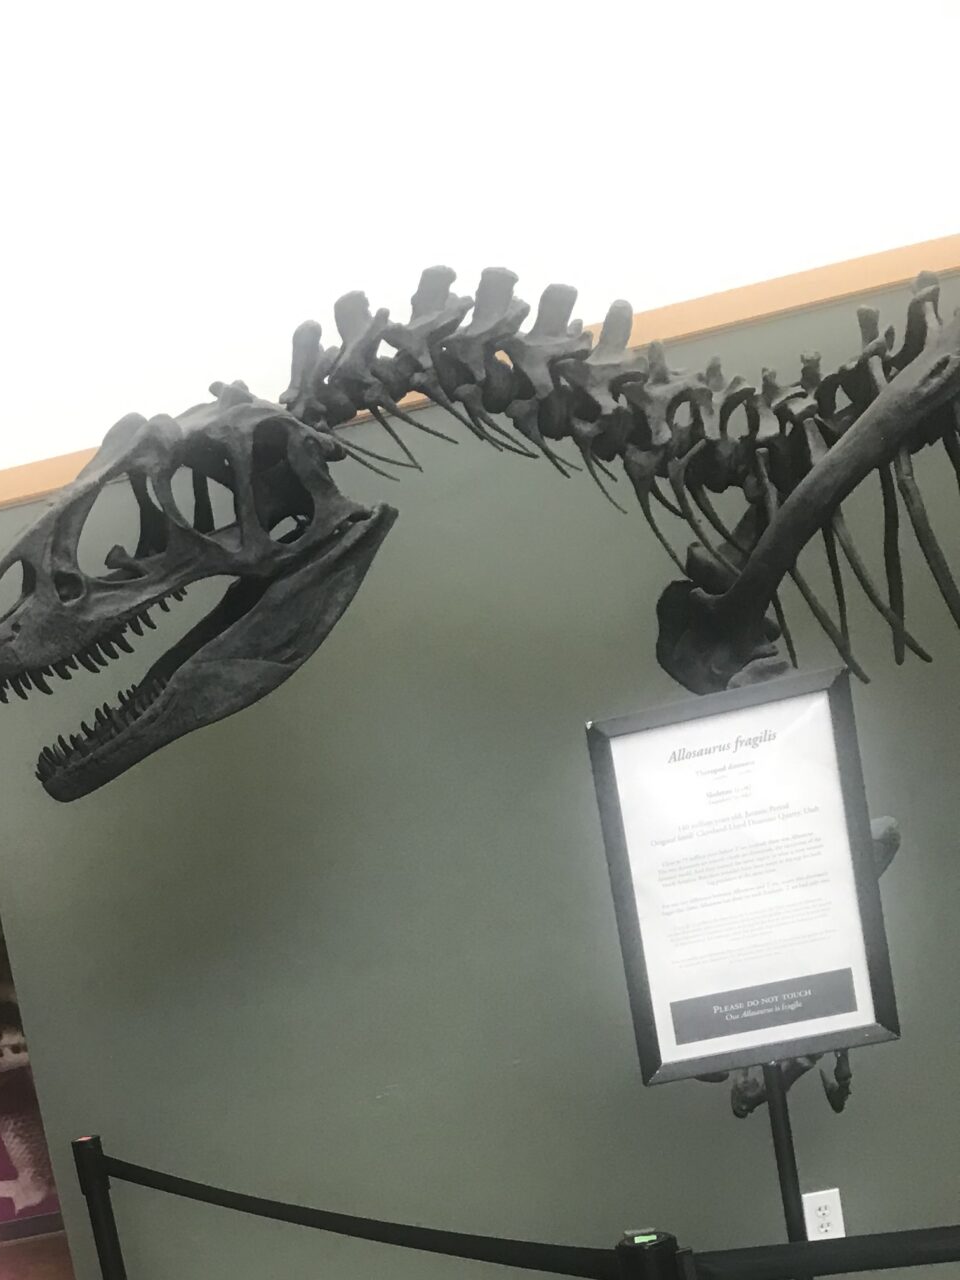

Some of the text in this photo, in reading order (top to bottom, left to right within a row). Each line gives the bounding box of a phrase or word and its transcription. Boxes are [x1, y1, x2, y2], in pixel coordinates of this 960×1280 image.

[668, 729, 777, 764] Allosaurus fragilis
[712, 989, 812, 1014] PLEASE DO NOT TOUCH
